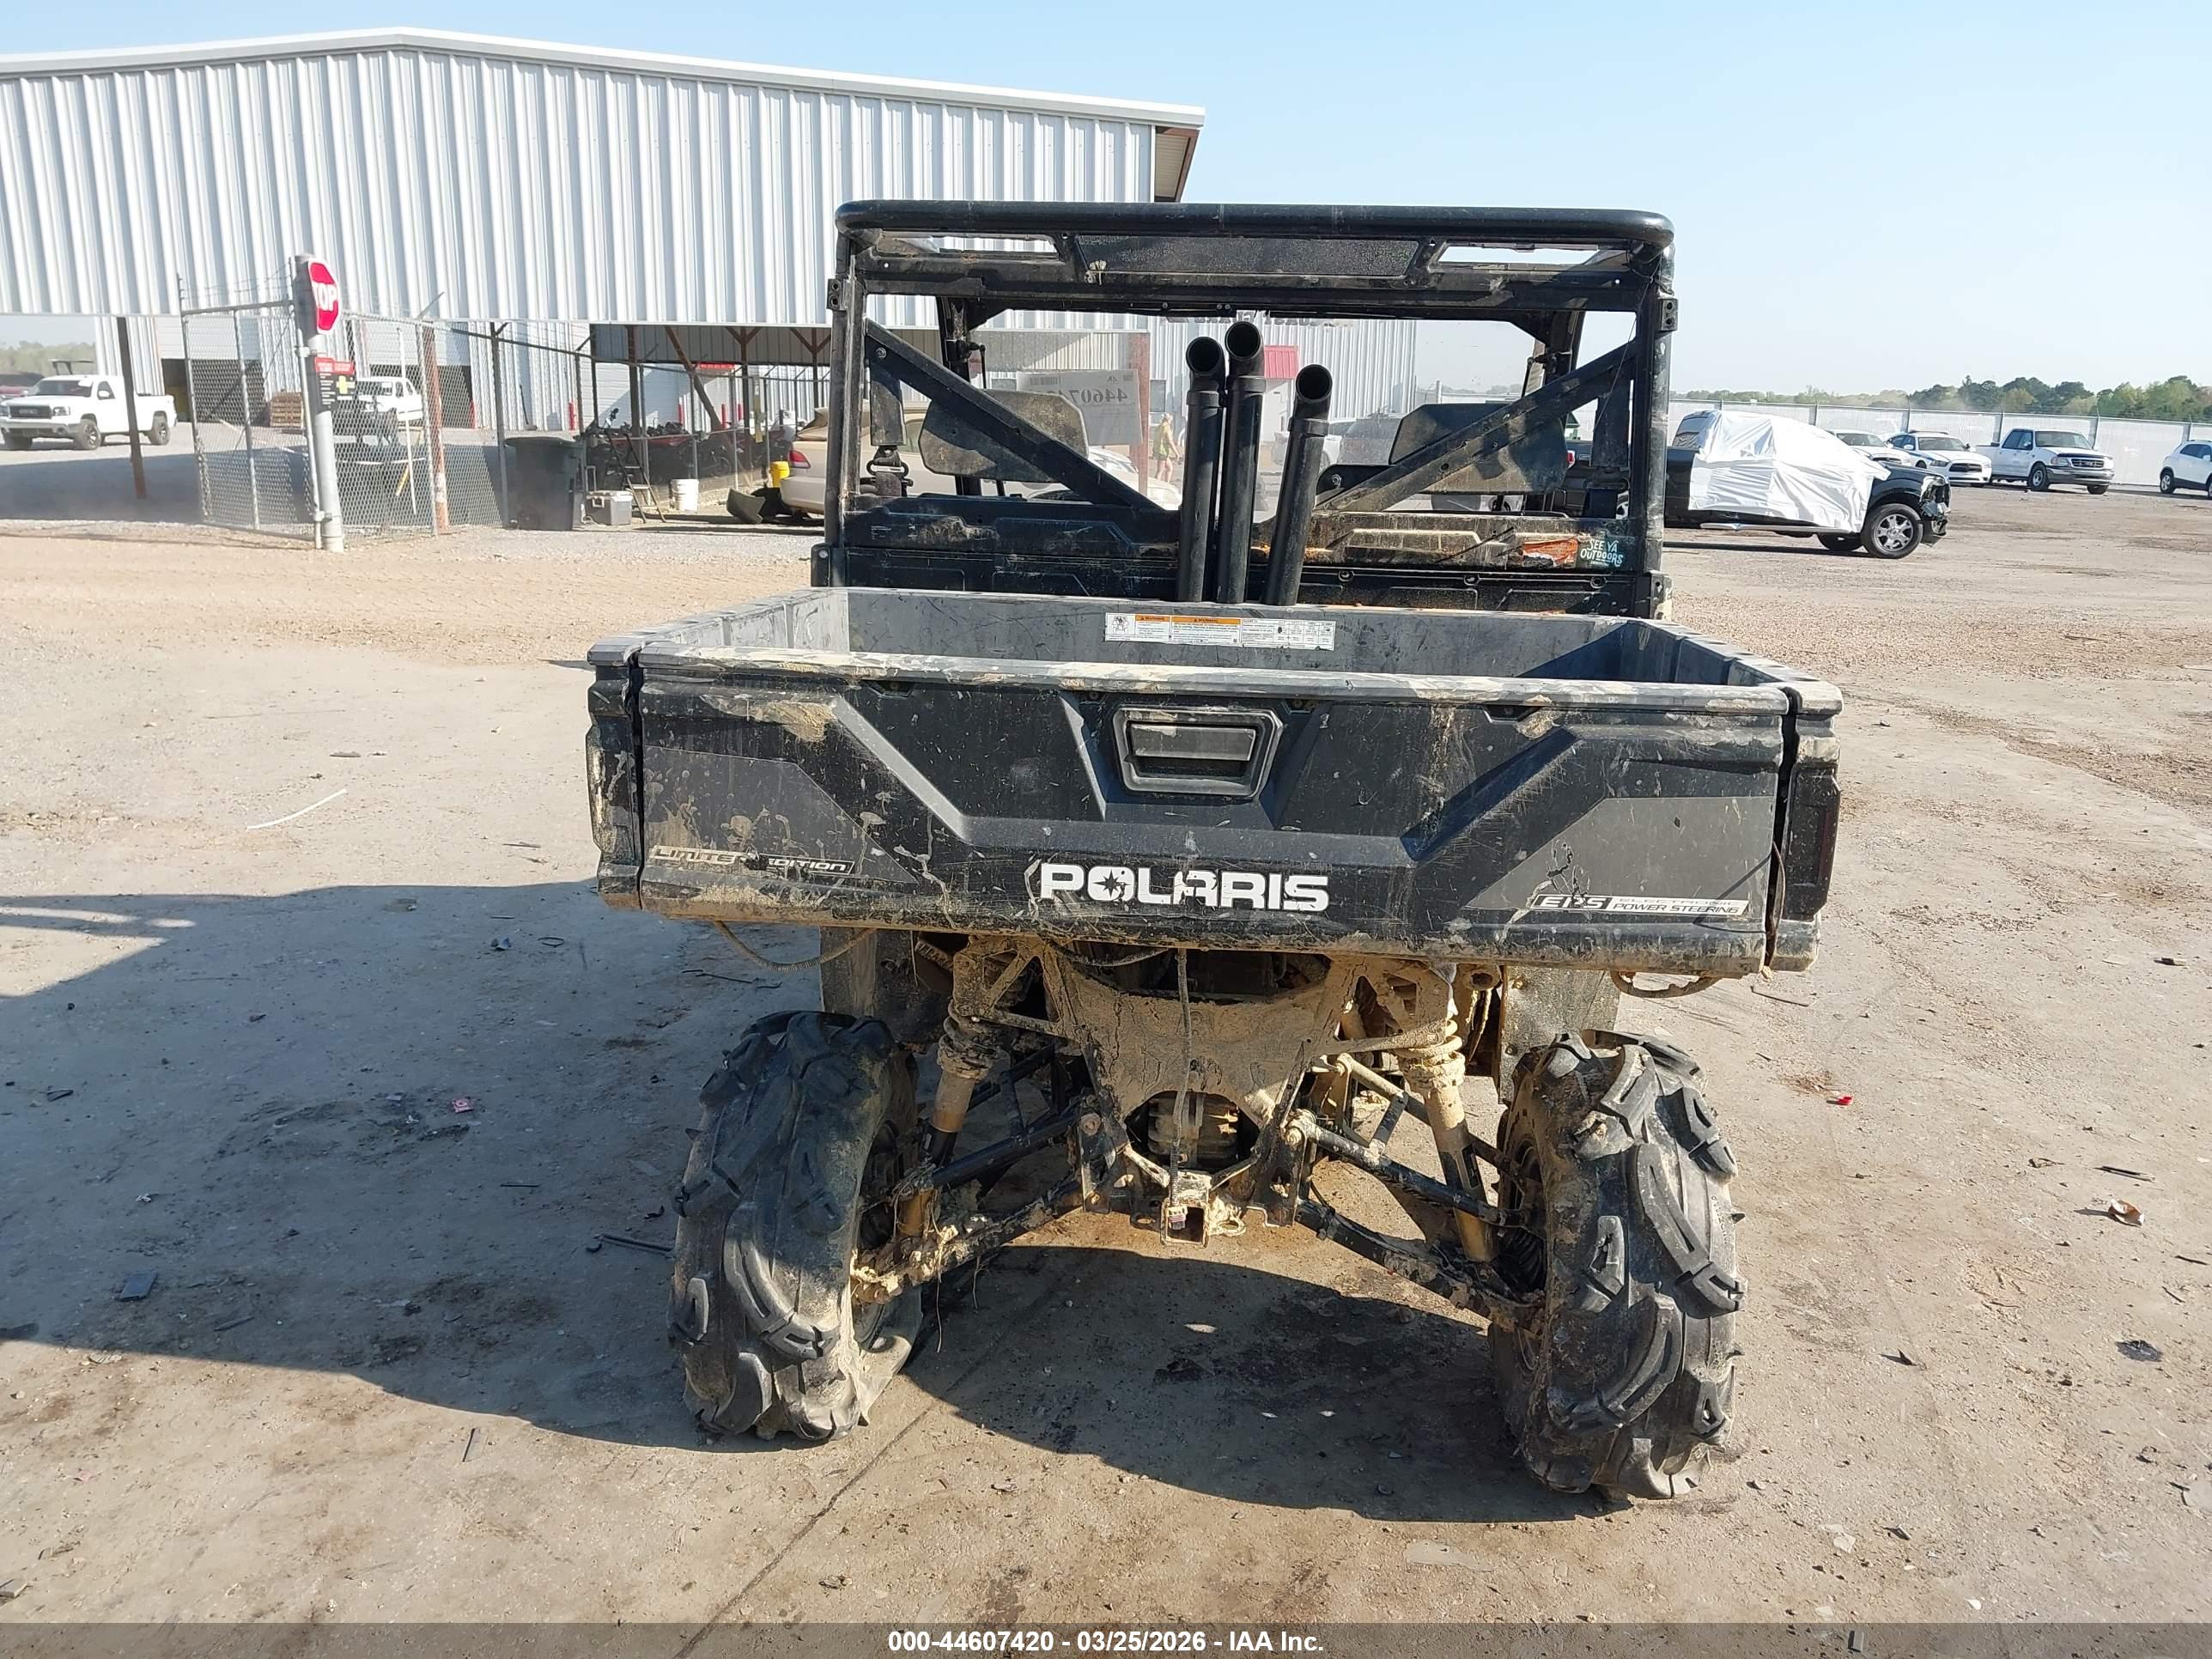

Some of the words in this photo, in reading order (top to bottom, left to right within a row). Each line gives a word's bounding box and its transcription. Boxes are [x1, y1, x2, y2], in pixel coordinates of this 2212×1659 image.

[312, 281, 338, 311] TOP
[1586, 538, 1605, 552] SEE
[1607, 539, 1620, 553] YA
[1580, 548, 1624, 567] OUTDOORS
[1040, 863, 1329, 912] POLARIS
[1539, 896, 1607, 909] EPS
[1613, 902, 1668, 912] POWER
[1671, 905, 1741, 914] STEERING
